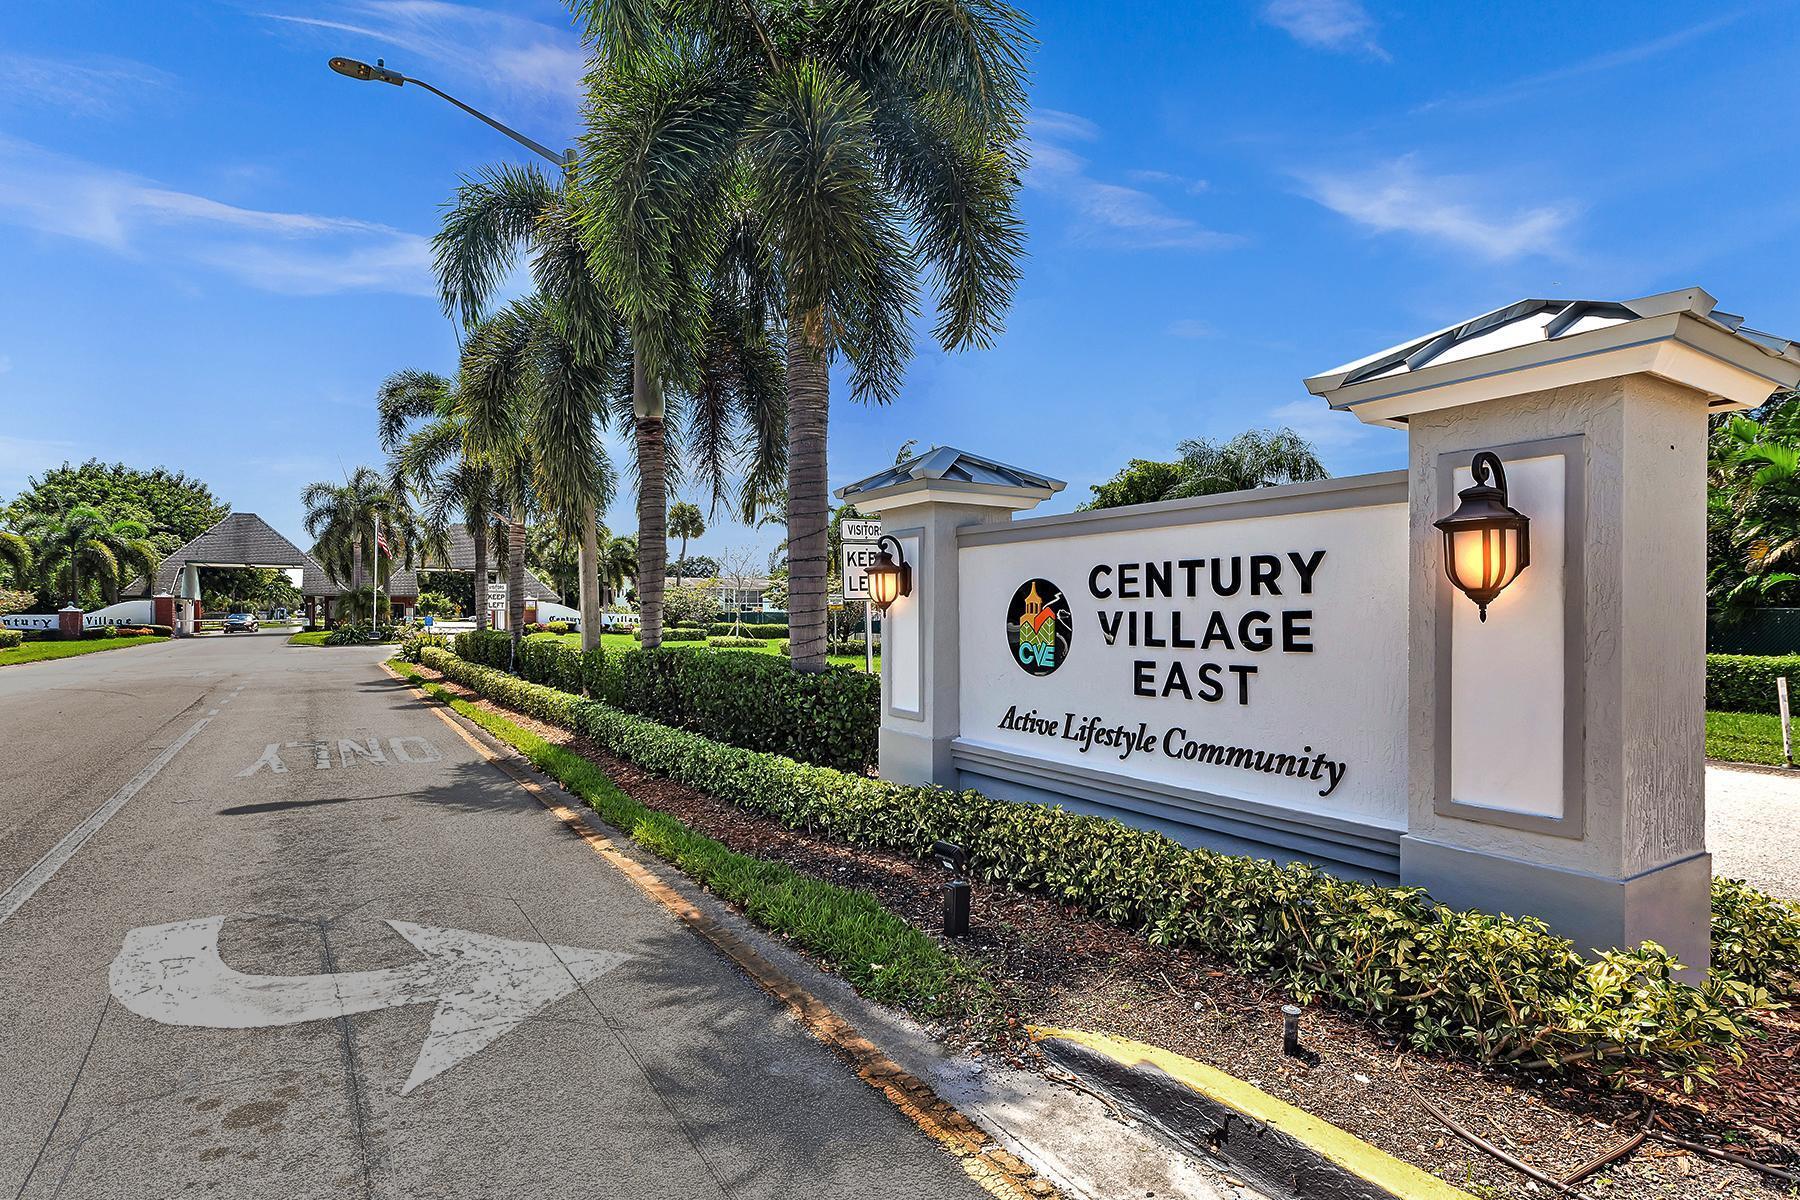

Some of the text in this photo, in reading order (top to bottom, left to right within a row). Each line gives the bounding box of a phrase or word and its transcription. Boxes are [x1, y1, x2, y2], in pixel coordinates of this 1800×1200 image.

[847, 524, 881, 536] VISITOR
[847, 551, 877, 567] KEE
[849, 575, 869, 591] LE
[1088, 550, 1327, 600] CENTURY
[2, 616, 132, 628] ntury Village
[608, 615, 641, 624] Villag
[1097, 609, 1315, 653] VILLAGE
[1019, 641, 1056, 667] CVE
[1133, 660, 1258, 706] EAST
[231, 735, 447, 778] ONLY
[998, 705, 1347, 797] Active Lifestyle Community
